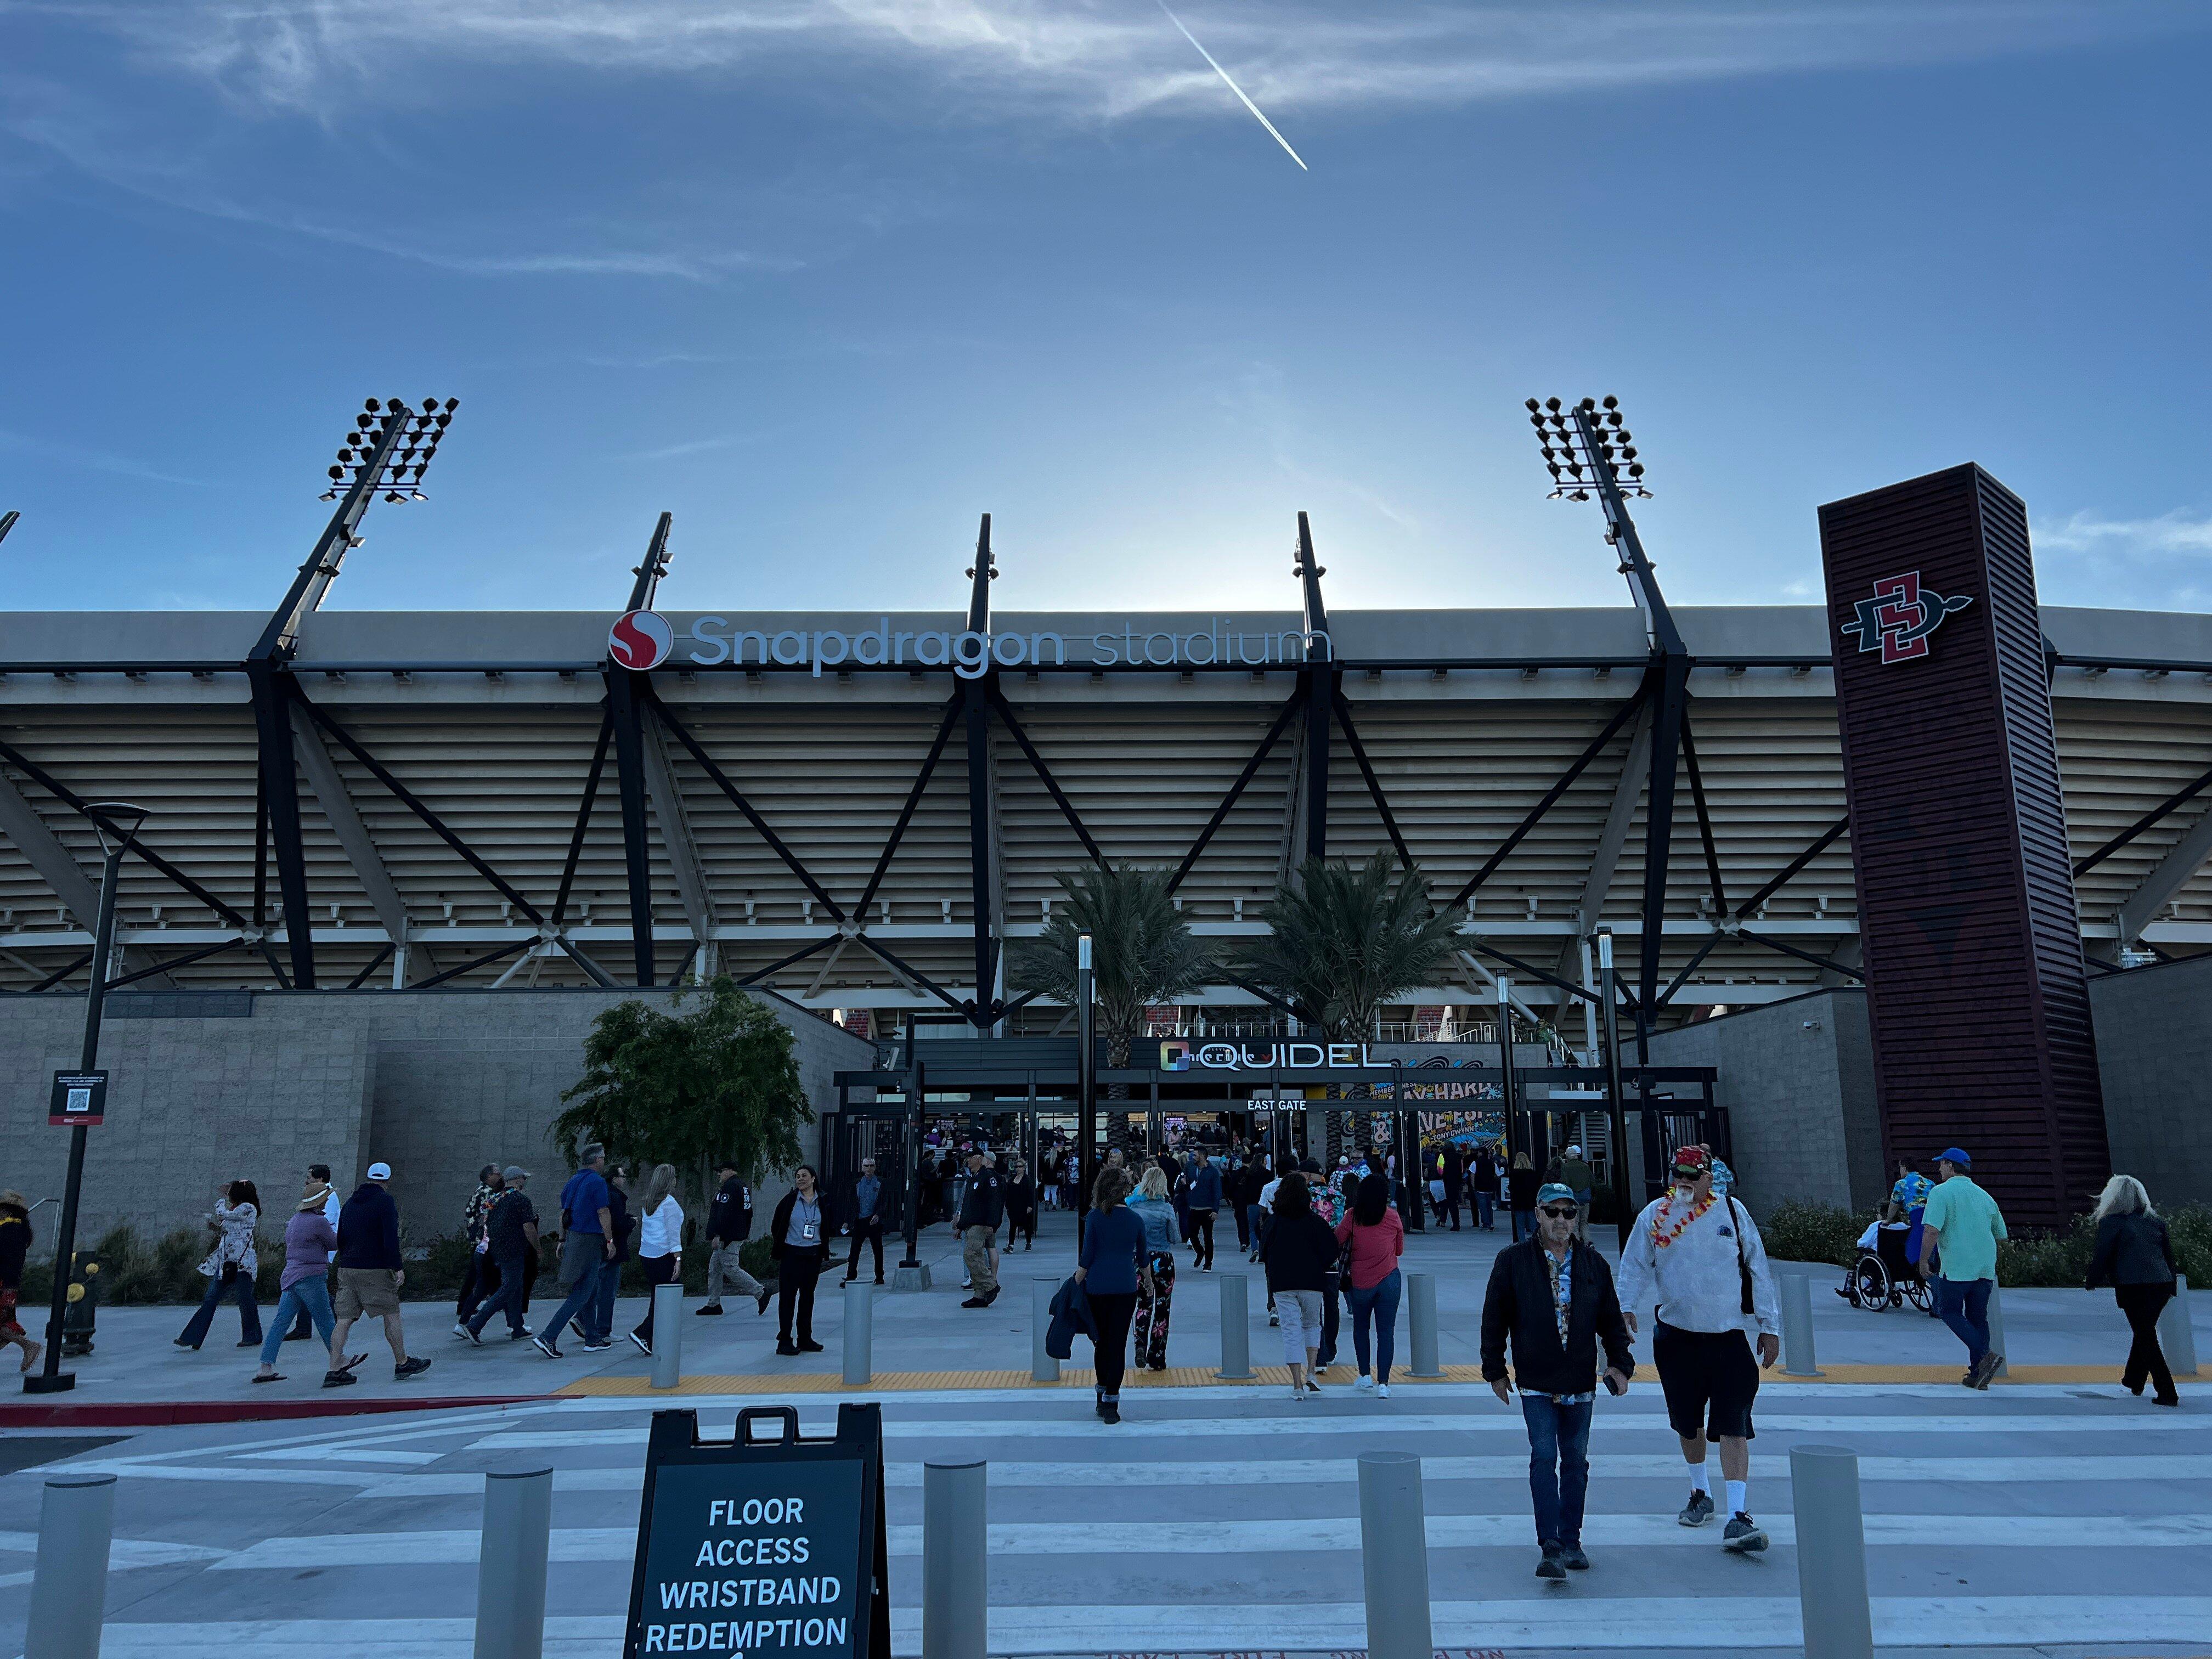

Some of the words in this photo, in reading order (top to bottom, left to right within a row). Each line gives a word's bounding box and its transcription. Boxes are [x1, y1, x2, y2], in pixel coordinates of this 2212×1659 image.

[690, 615, 1064, 680] Snapdragon
[1092, 617, 1332, 665] stadium
[1199, 1043, 1392, 1071] QUIDEL
[1248, 1100, 1275, 1110] EAST
[1278, 1100, 1307, 1110] GATE
[1450, 1125, 1476, 1136] GWYNN
[709, 1498, 804, 1526] FLOOR
[695, 1537, 809, 1567] ACCESS
[659, 1576, 840, 1610] WRISTBAND
[645, 1617, 847, 1652] REDEMPTION
